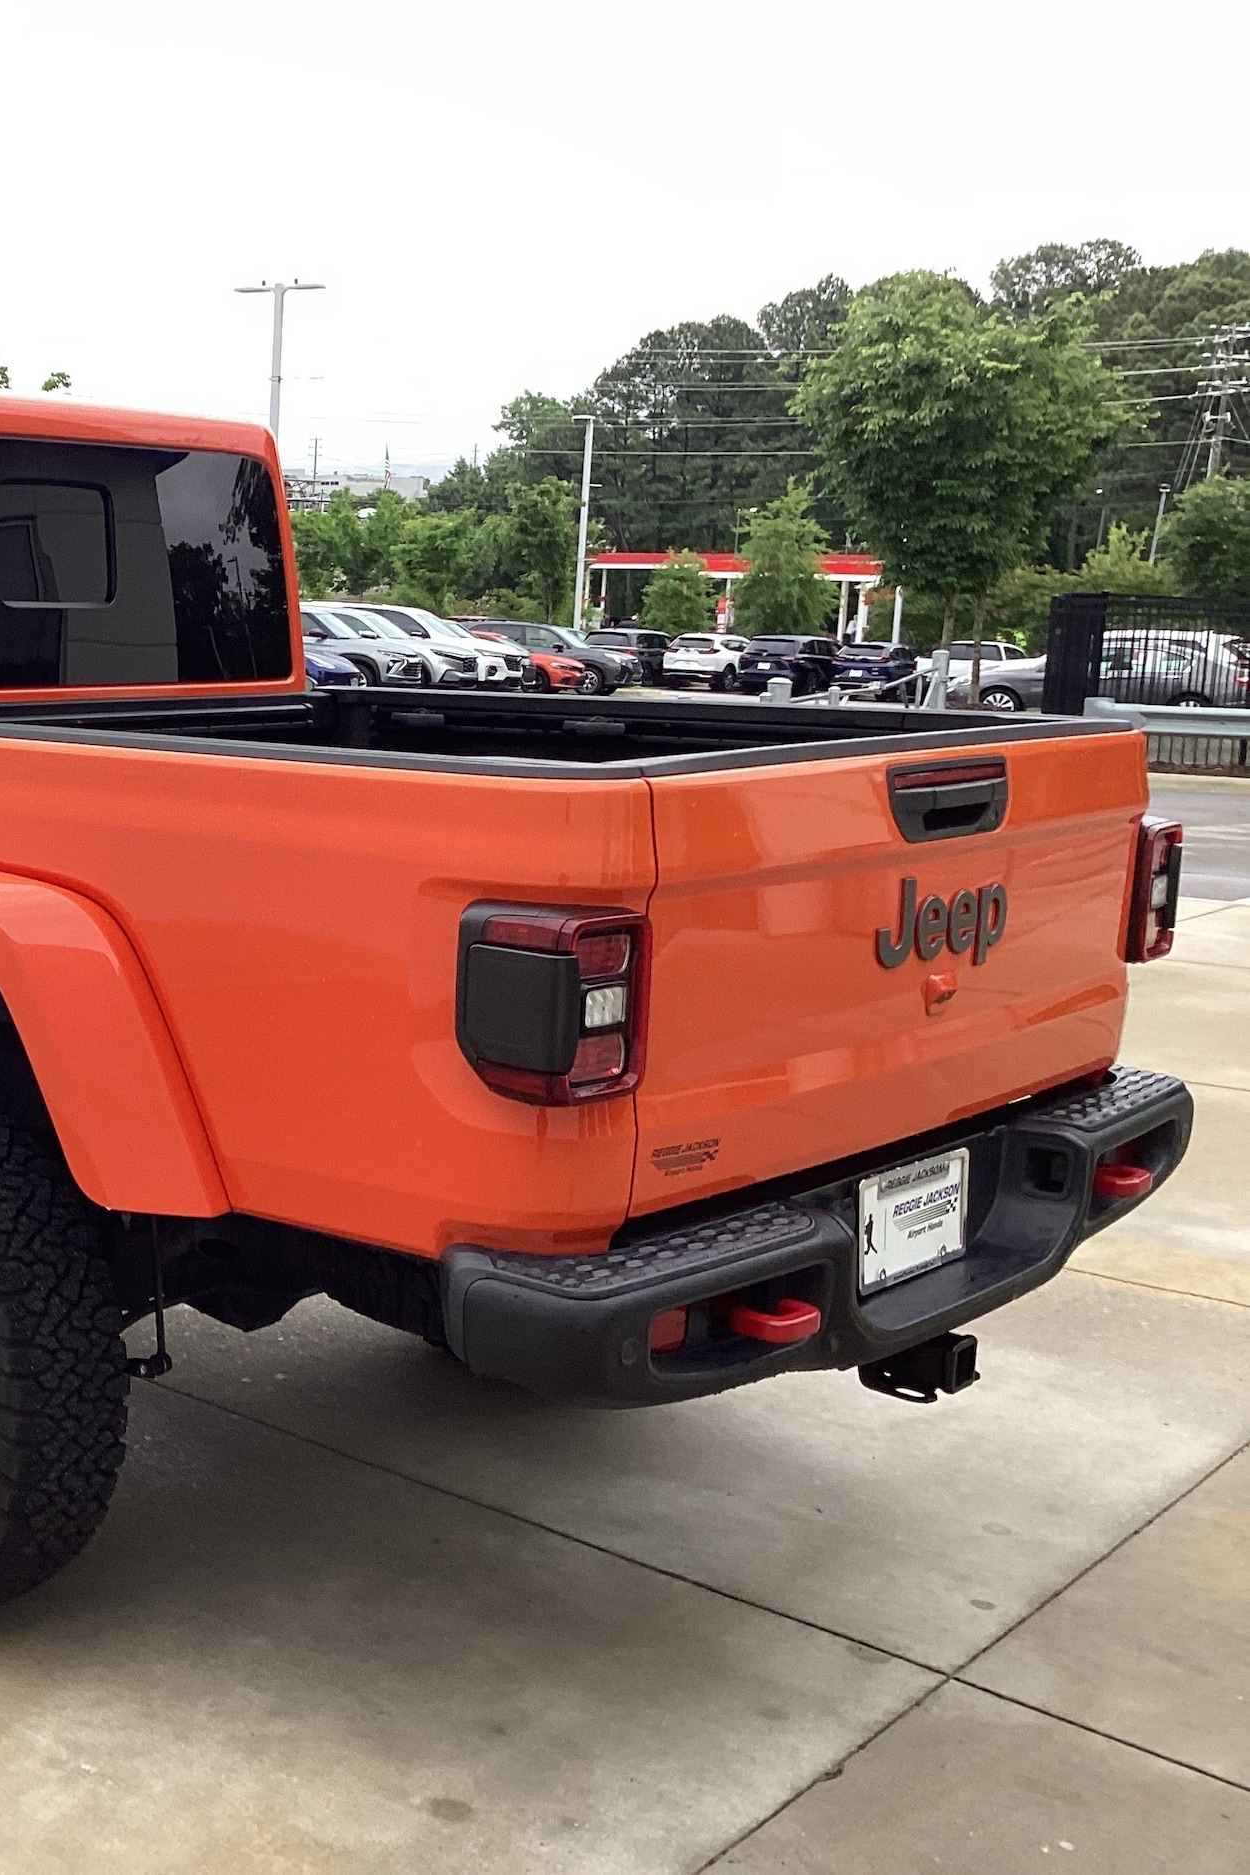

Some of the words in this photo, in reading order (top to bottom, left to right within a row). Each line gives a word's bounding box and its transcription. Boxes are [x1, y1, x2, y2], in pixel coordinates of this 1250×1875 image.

[874, 876, 1008, 969] Jeep
[892, 1195, 922, 1217] REGGIE
[923, 1181, 960, 1207] JACKSON
[906, 1223, 926, 1240] Airport
[926, 1219, 944, 1232] Honda
